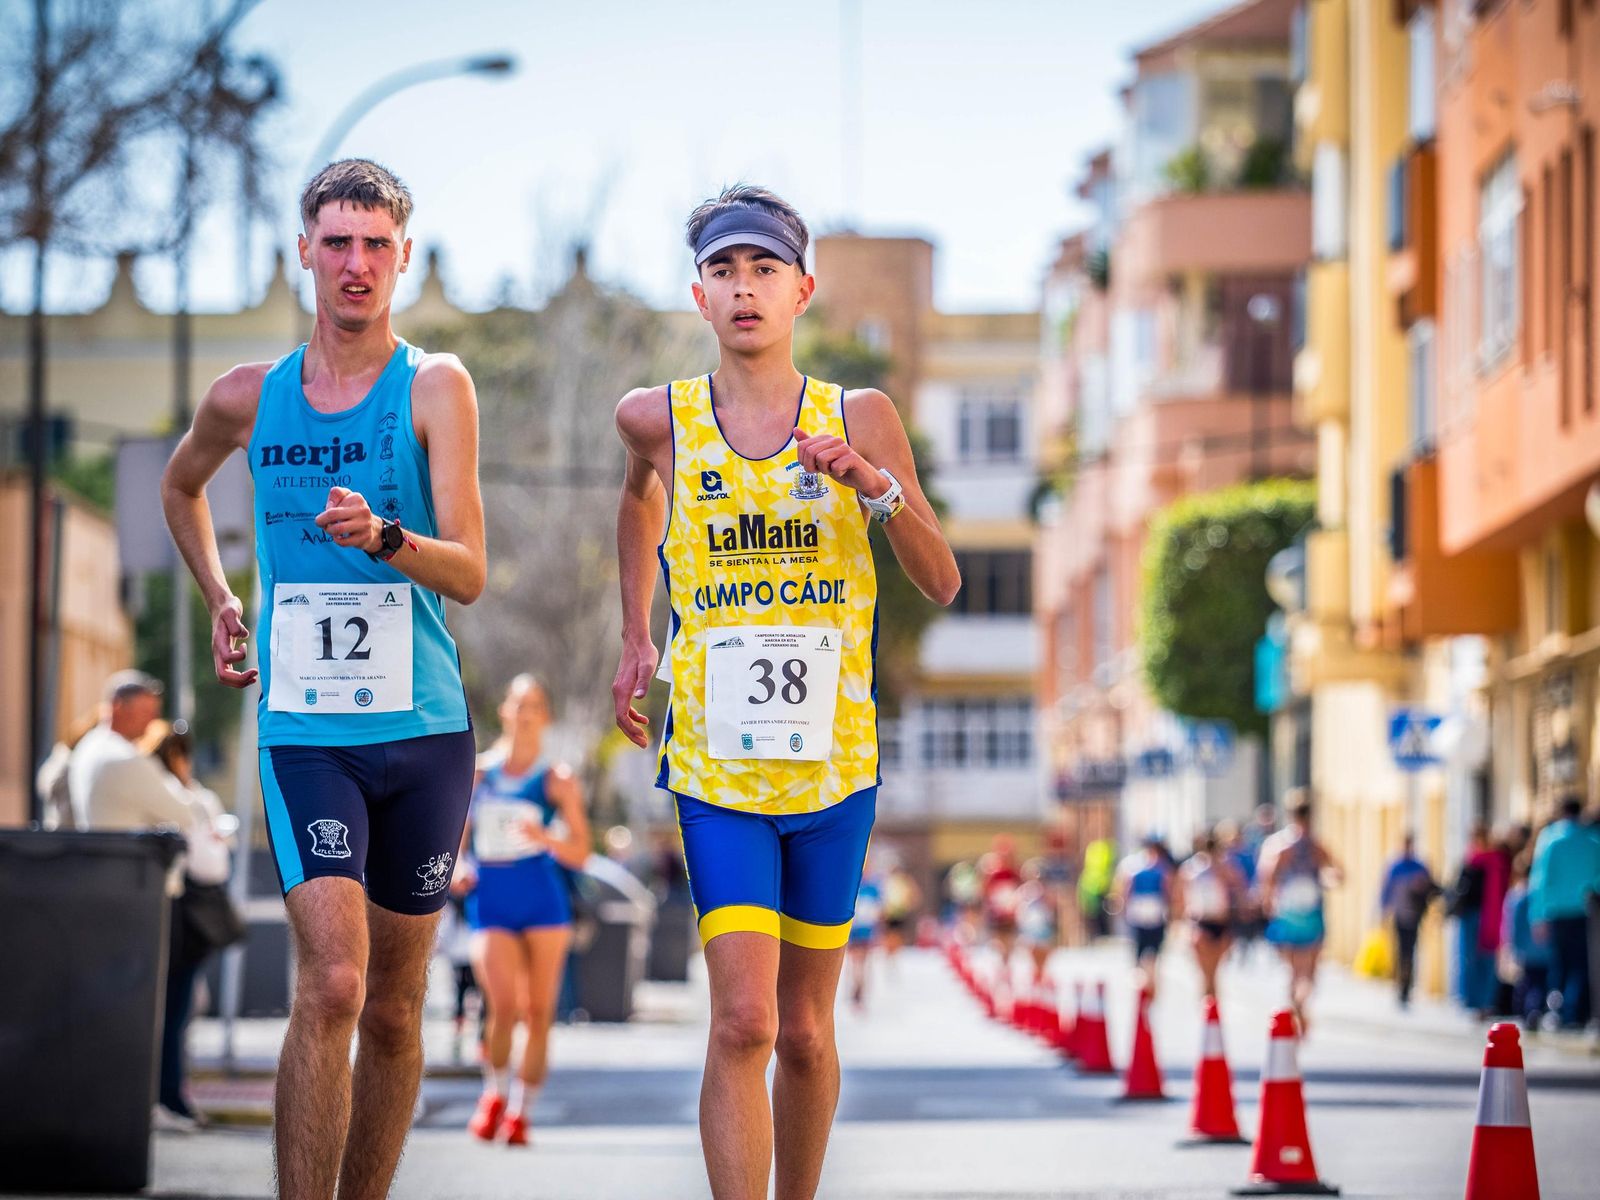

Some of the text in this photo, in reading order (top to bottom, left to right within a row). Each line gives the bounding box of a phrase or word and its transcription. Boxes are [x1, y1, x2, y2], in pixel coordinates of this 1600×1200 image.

[260, 436, 367, 474] nerja
[272, 474, 352, 489] ATLETISMO
[726, 557, 763, 567] SIENTA
[772, 557, 786, 565] LA
[790, 556, 819, 564] MESA
[315, 616, 372, 661] 12
[748, 658, 808, 705] 38
